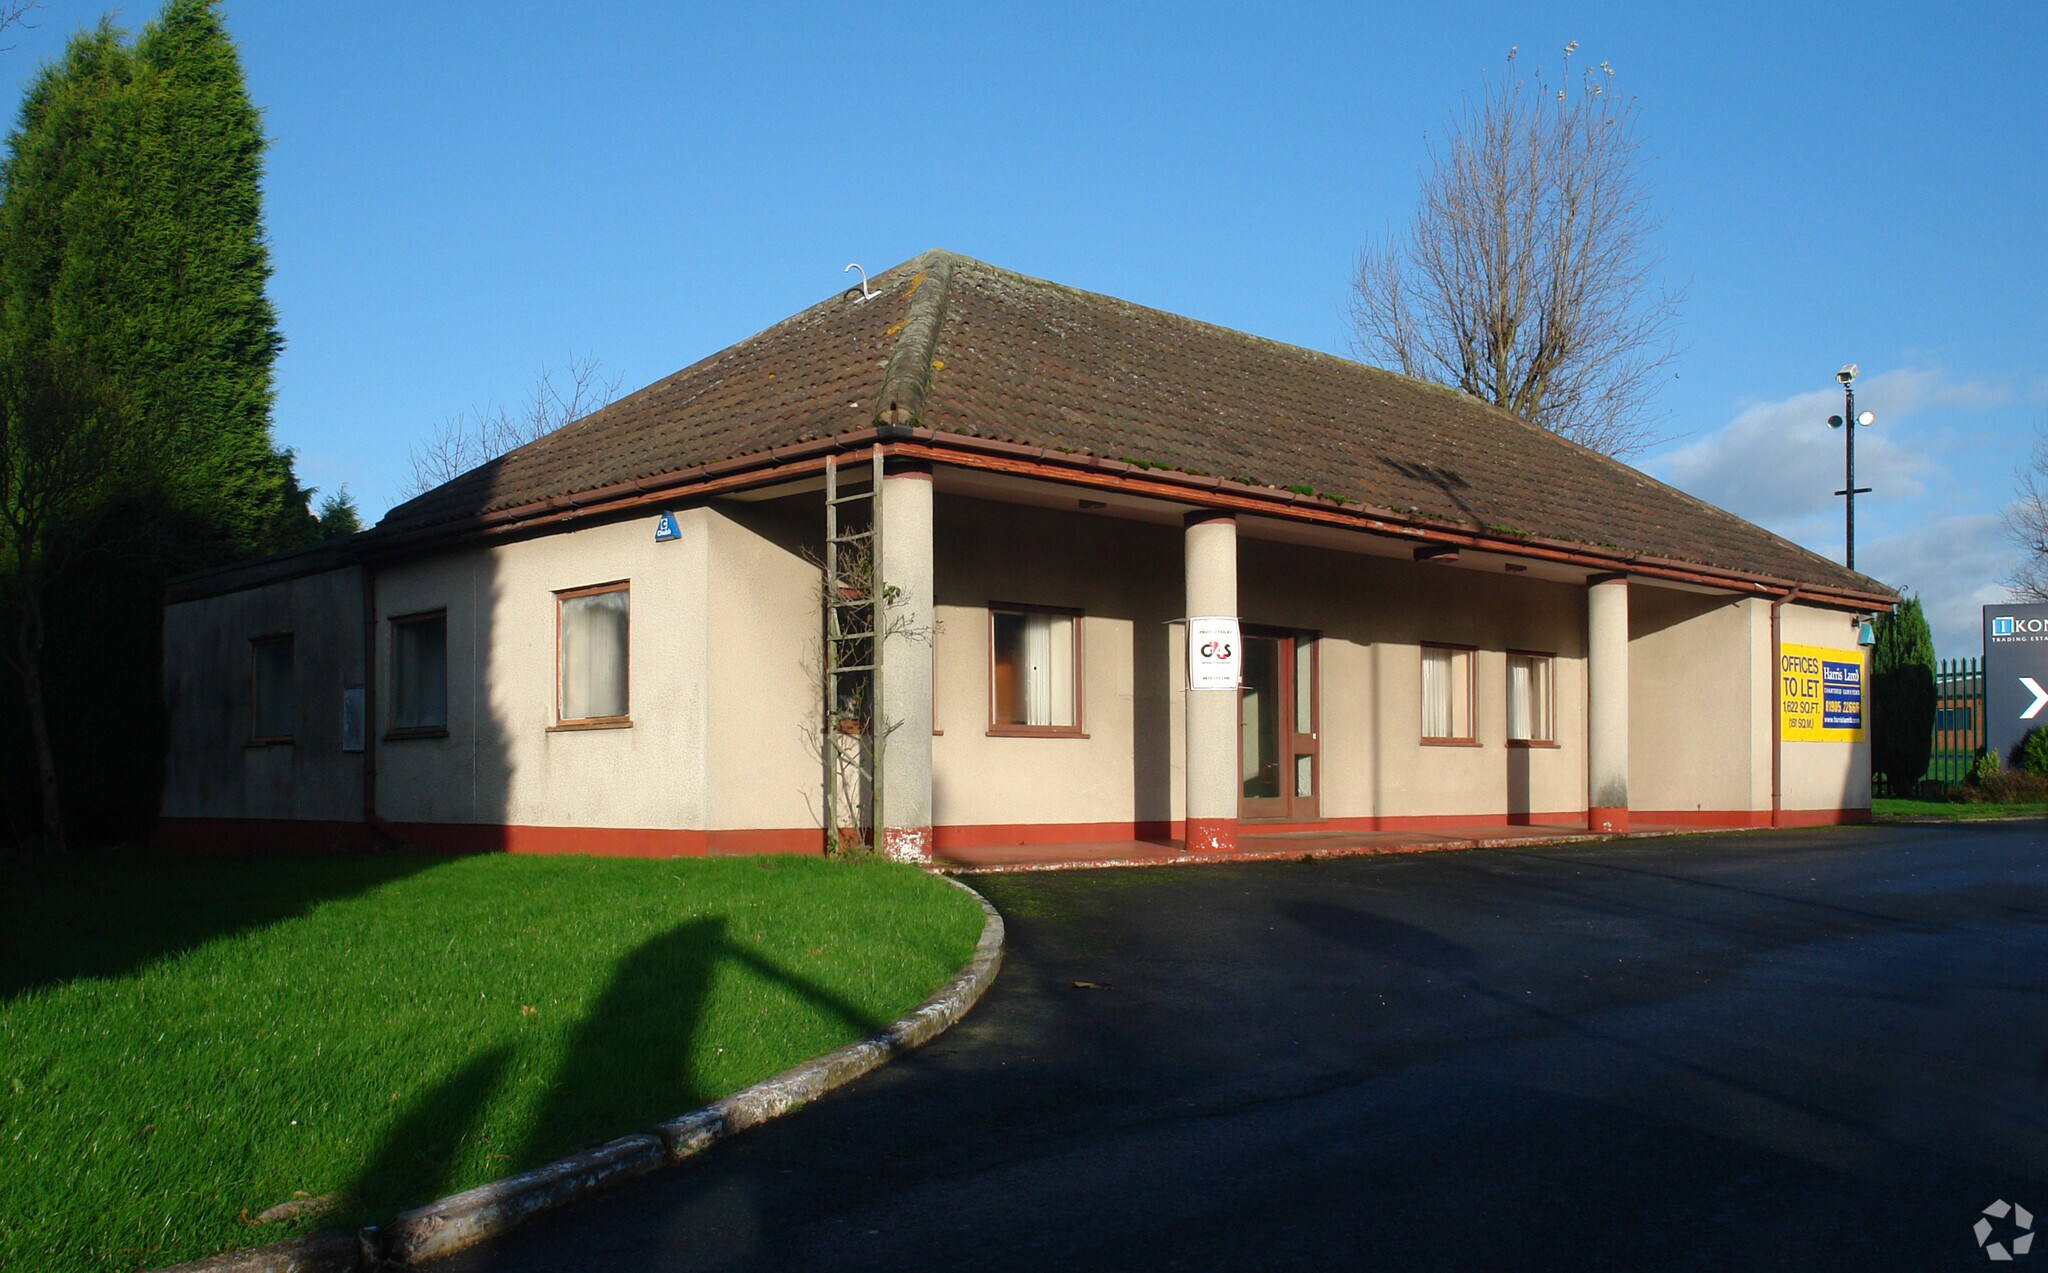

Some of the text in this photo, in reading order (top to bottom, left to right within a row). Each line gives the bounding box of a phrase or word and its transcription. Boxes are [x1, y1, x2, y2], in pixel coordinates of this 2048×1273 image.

[1201, 641, 1231, 659] G4S
[1781, 655, 1819, 674] OFFICES
[1823, 667, 1859, 682] Harris Lamb
[1783, 677, 1819, 698] TO LET
